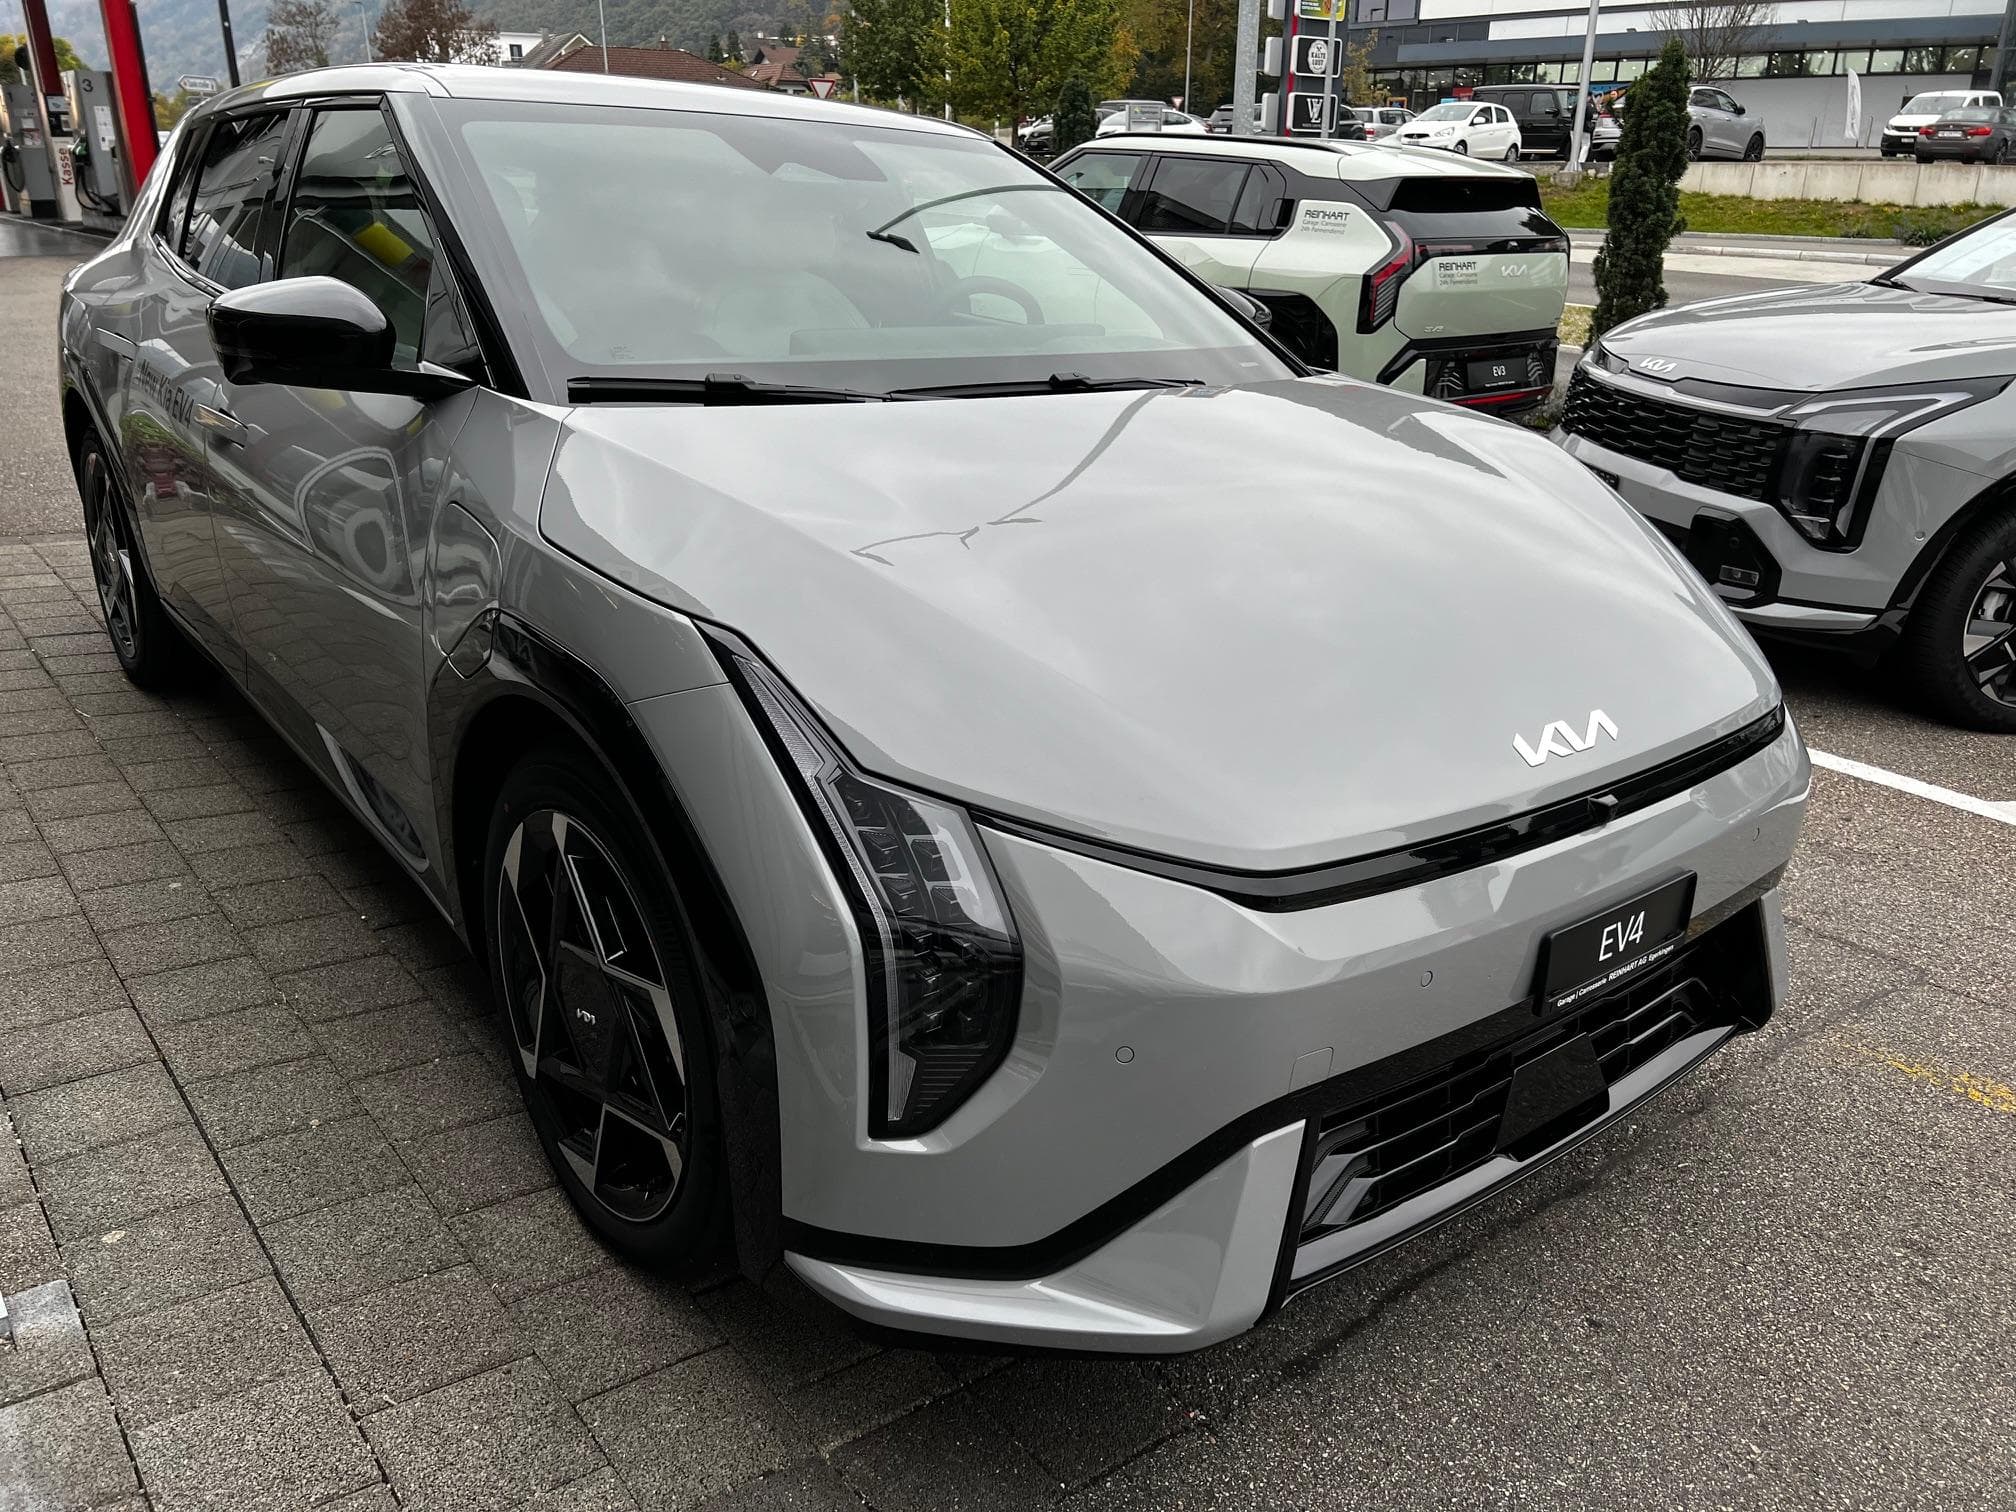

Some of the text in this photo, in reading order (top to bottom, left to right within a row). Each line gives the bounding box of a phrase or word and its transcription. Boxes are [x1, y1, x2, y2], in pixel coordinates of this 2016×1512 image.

[82, 78, 94, 93] 3
[58, 148, 74, 186] Kasse
[1304, 209, 1351, 221] REINHART
[1438, 261, 1477, 272] REINHART
[1492, 365, 1507, 377] EV3
[158, 374, 173, 413] Kia
[172, 386, 195, 430] EV4
[1598, 910, 1645, 962] EV4
[1556, 994, 1576, 1007] Garage
[1578, 977, 1608, 996] Carrosserie
[1608, 960, 1639, 982] REINHART
[1637, 956, 1648, 967] AG
[1648, 945, 1675, 962] Egerkingen
